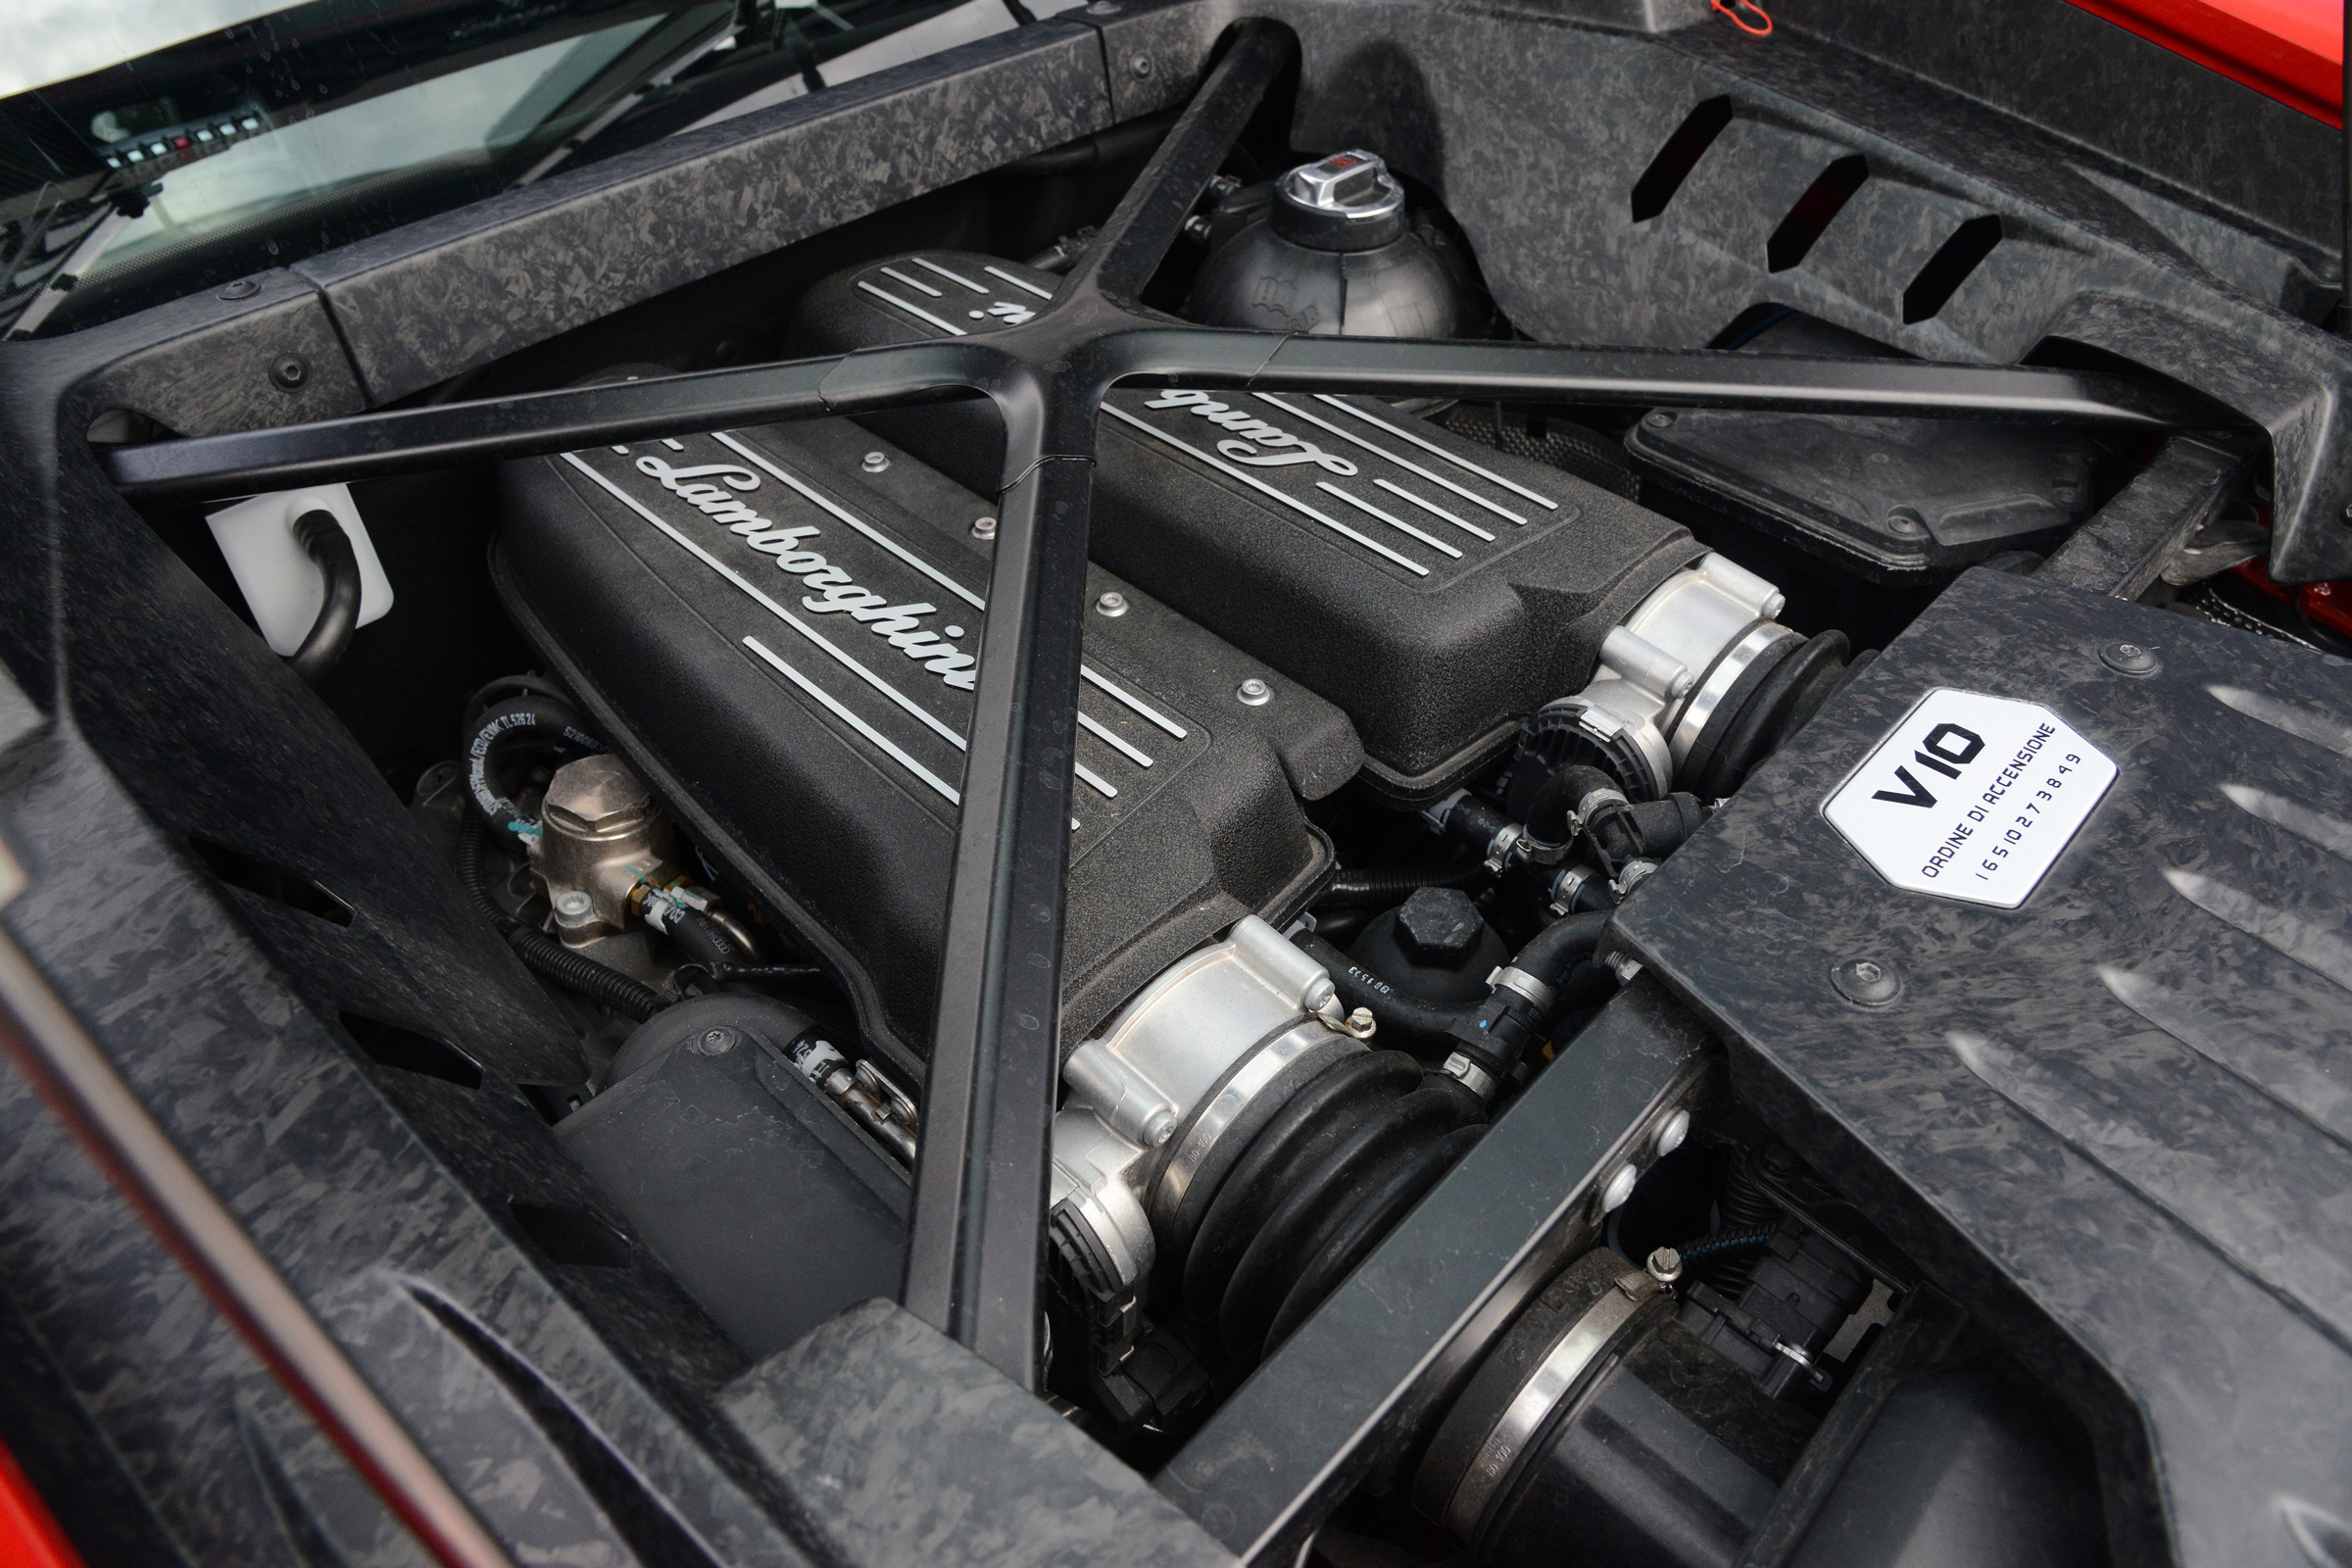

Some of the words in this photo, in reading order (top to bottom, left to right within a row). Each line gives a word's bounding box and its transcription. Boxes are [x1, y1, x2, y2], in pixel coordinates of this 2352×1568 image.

[1871, 722, 1986, 809] V10
[1921, 822, 1974, 879] ORDINE
[1967, 805, 1989, 823] DI
[1982, 722, 2056, 806] ACCENSIONE
